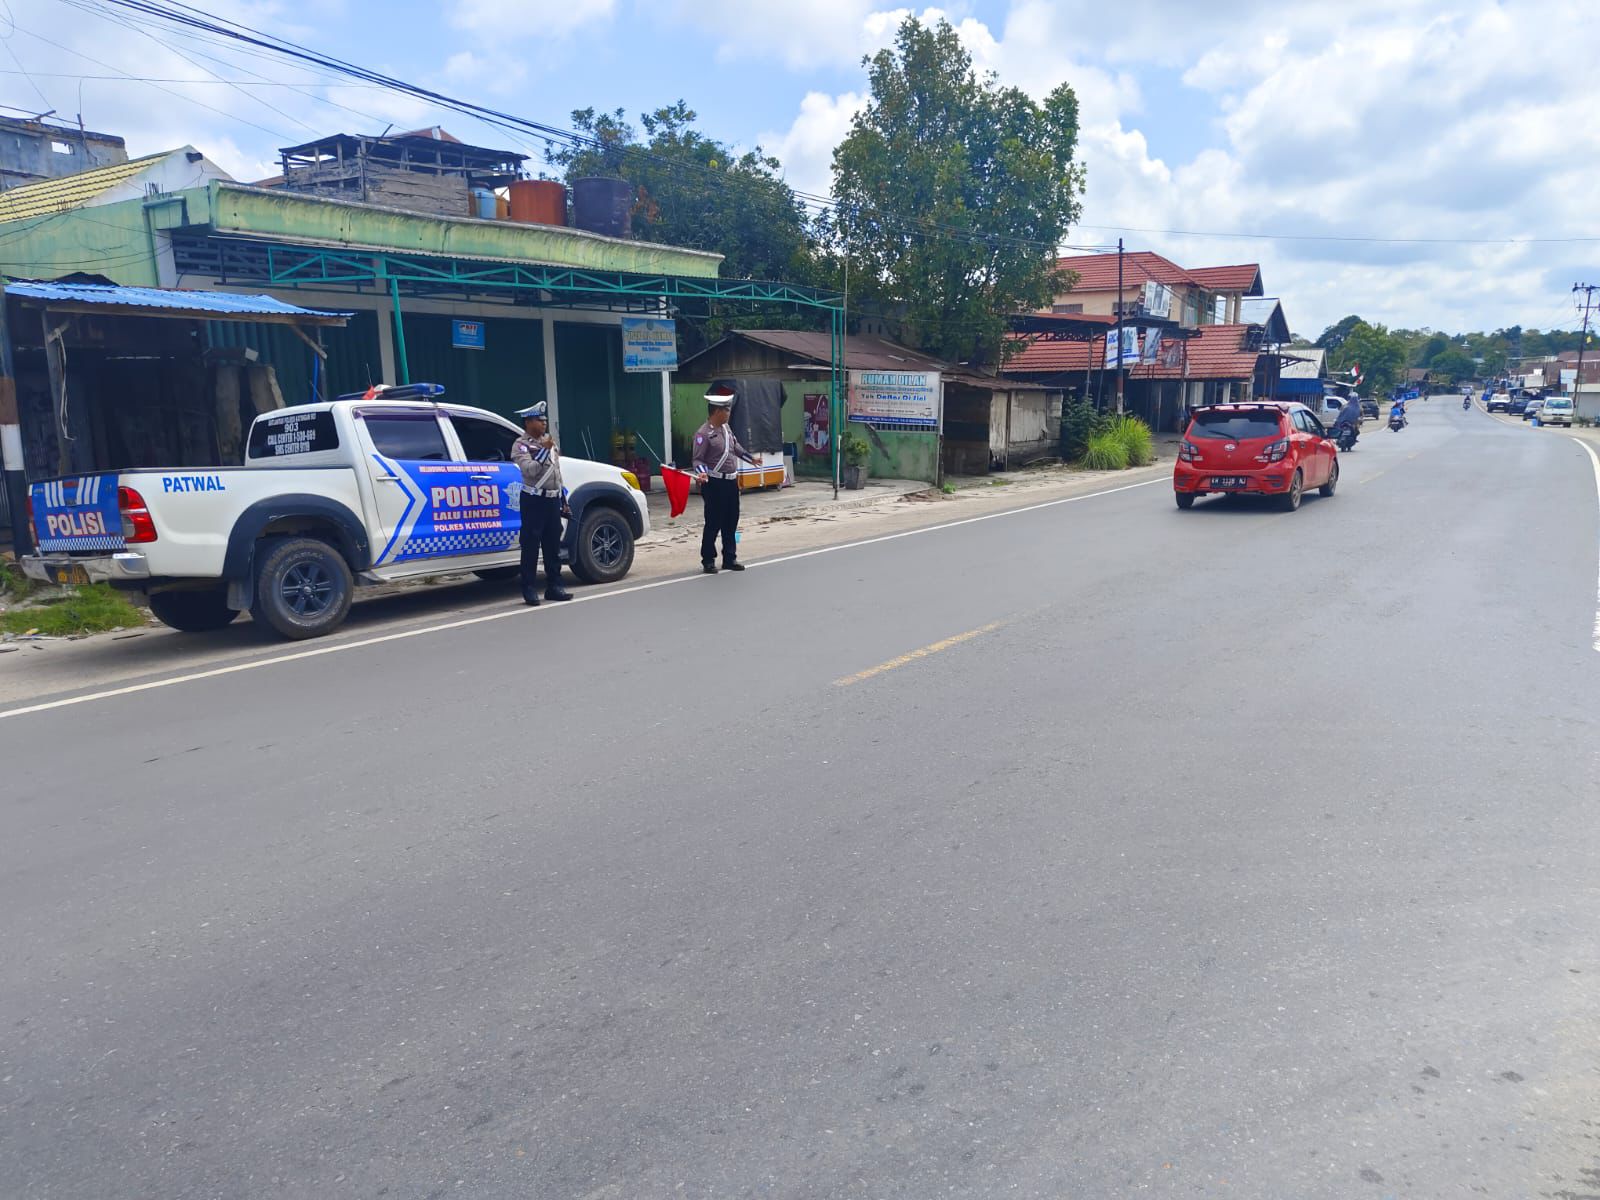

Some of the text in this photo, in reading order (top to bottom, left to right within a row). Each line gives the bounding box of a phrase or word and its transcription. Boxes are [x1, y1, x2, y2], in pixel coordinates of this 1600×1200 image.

[861, 373, 926, 386] RUMAH DILAN
[284, 422, 299, 432] 903
[267, 434, 278, 445] CALL
[278, 432, 293, 444] CENTER
[275, 445, 285, 455] SMS
[285, 443, 300, 454] CENTER
[162, 476, 225, 492] PATWAL
[431, 484, 500, 508] POLISI
[433, 508, 500, 521] LALU LINTAS
[47, 511, 107, 537] POLISI
[434, 521, 502, 532] POLRES KATINGAN
